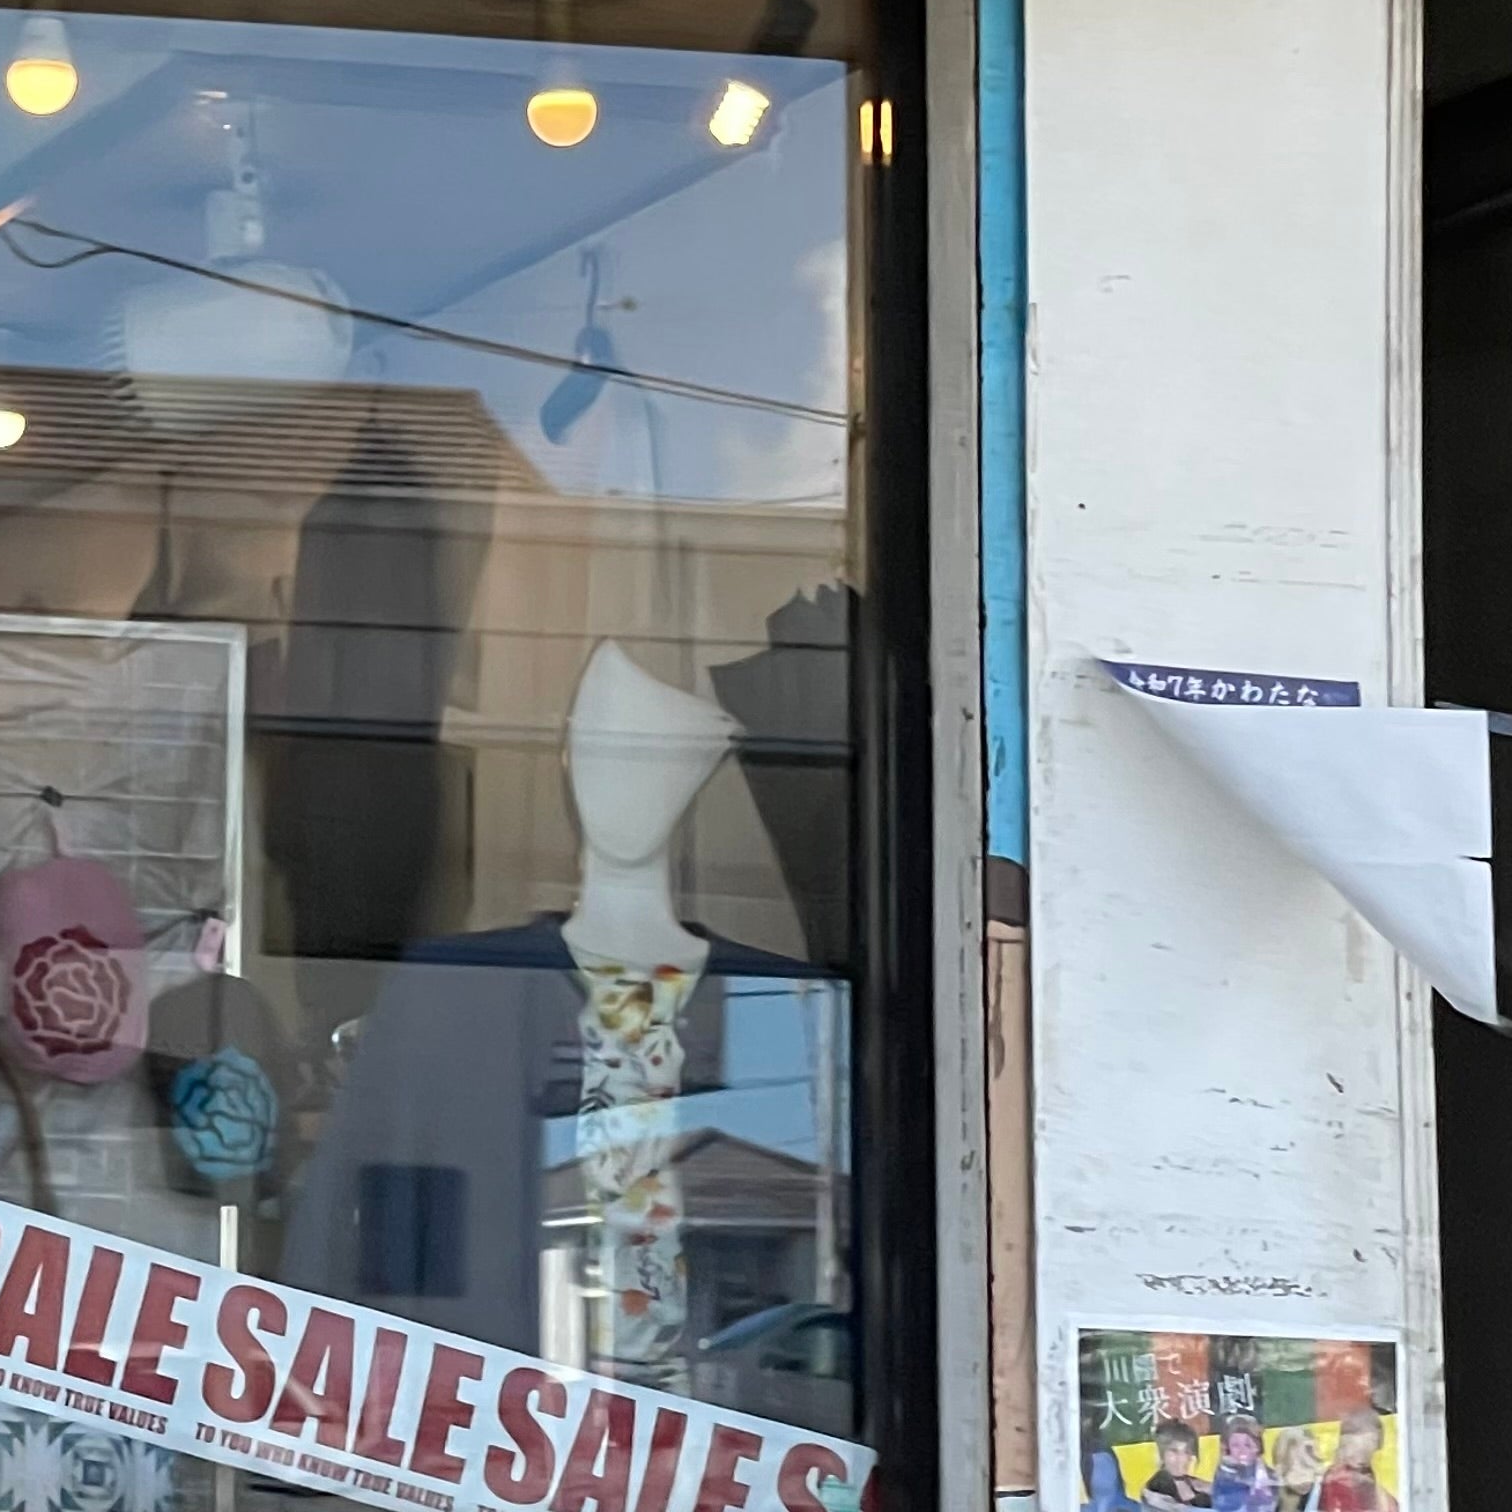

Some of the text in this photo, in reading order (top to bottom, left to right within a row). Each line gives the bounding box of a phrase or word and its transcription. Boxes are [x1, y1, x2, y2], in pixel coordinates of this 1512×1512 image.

[201, 1284, 485, 1485] SALE
[1092, 1372, 1257, 1431] 大衆演劇
